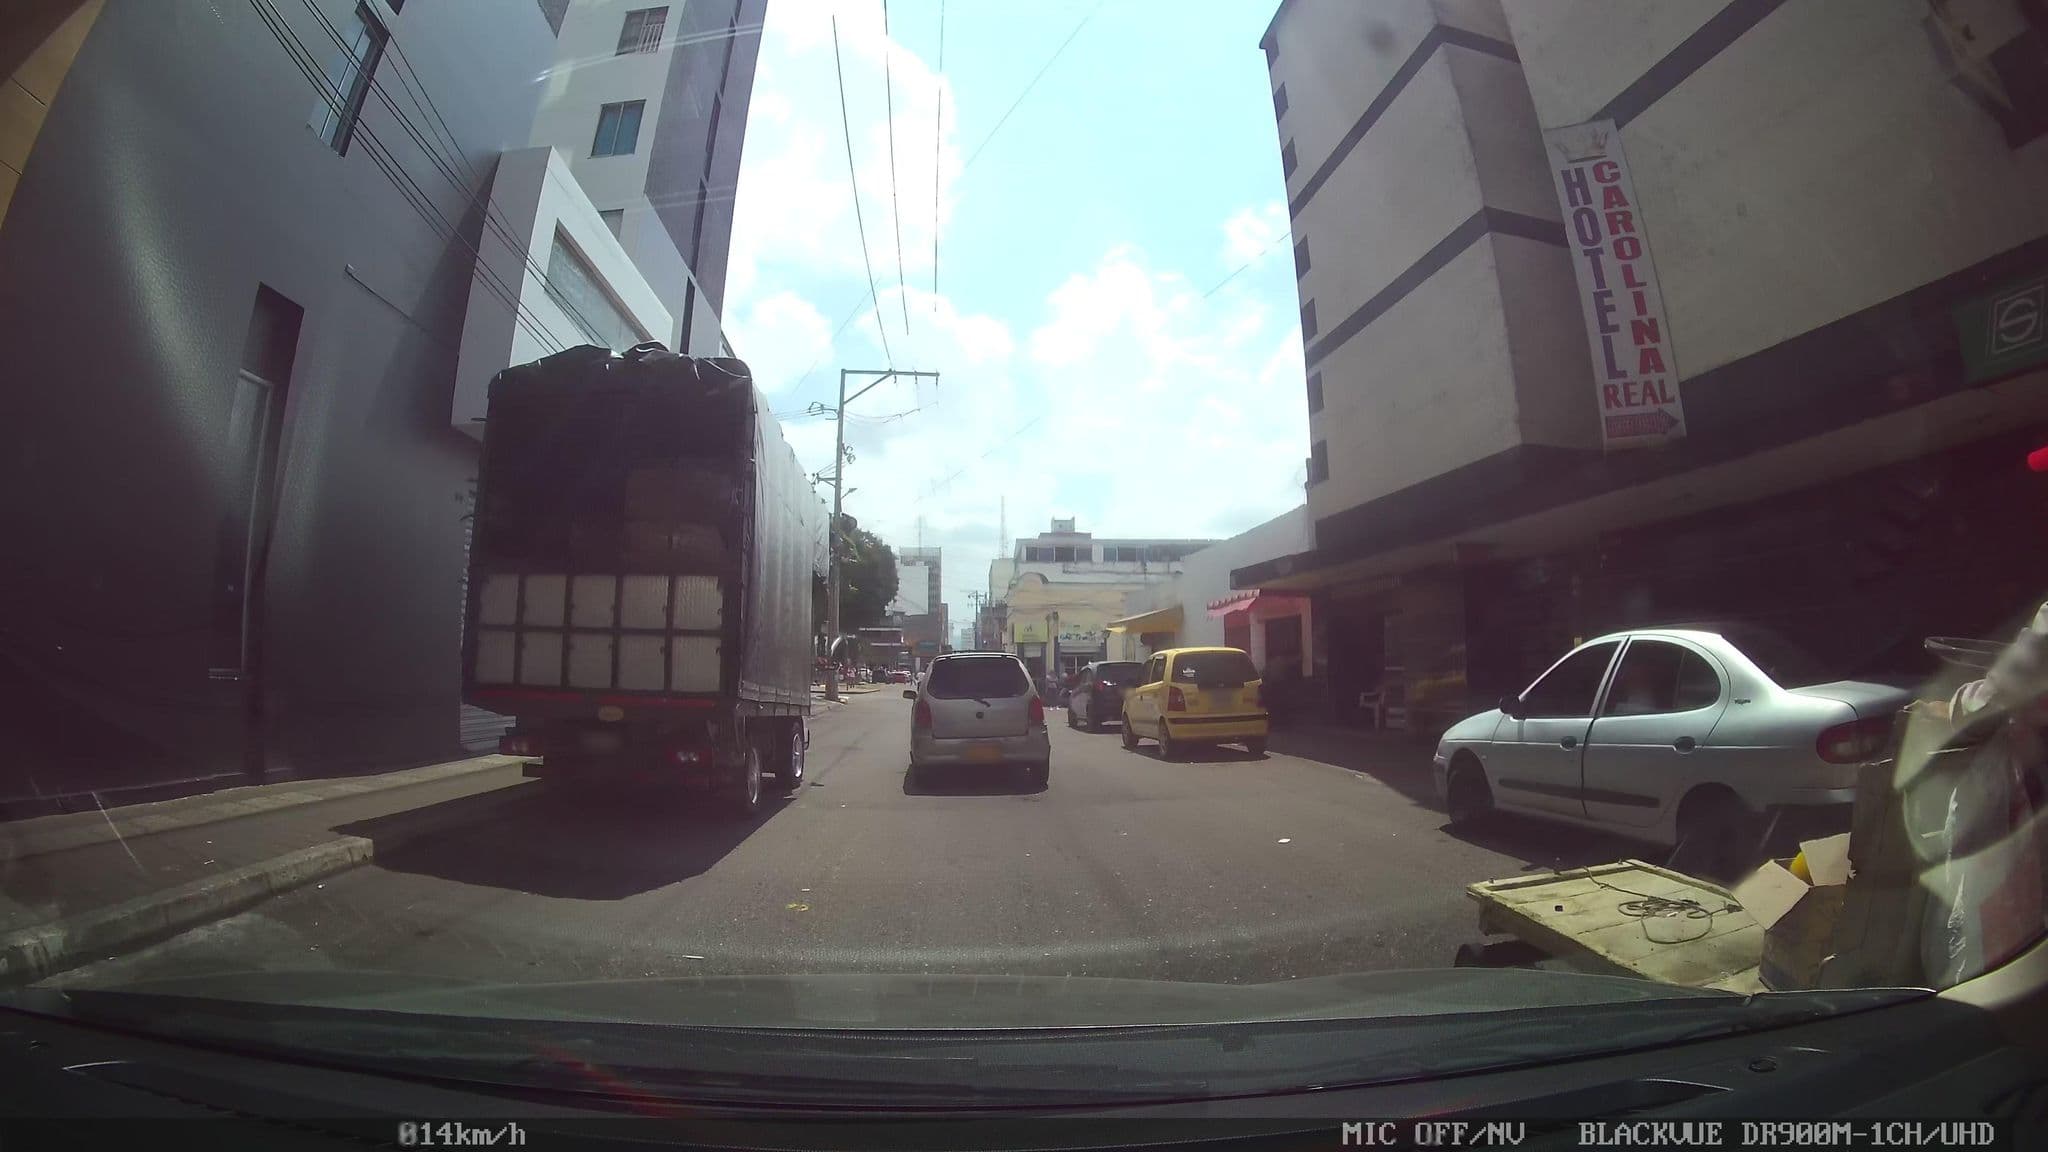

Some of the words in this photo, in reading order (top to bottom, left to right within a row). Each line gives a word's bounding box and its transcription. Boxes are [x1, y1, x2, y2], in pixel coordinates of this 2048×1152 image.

[1562, 169, 1627, 379] HOTEL
[1593, 161, 1666, 374] CAROLINA
[1603, 380, 1675, 409] REAL
